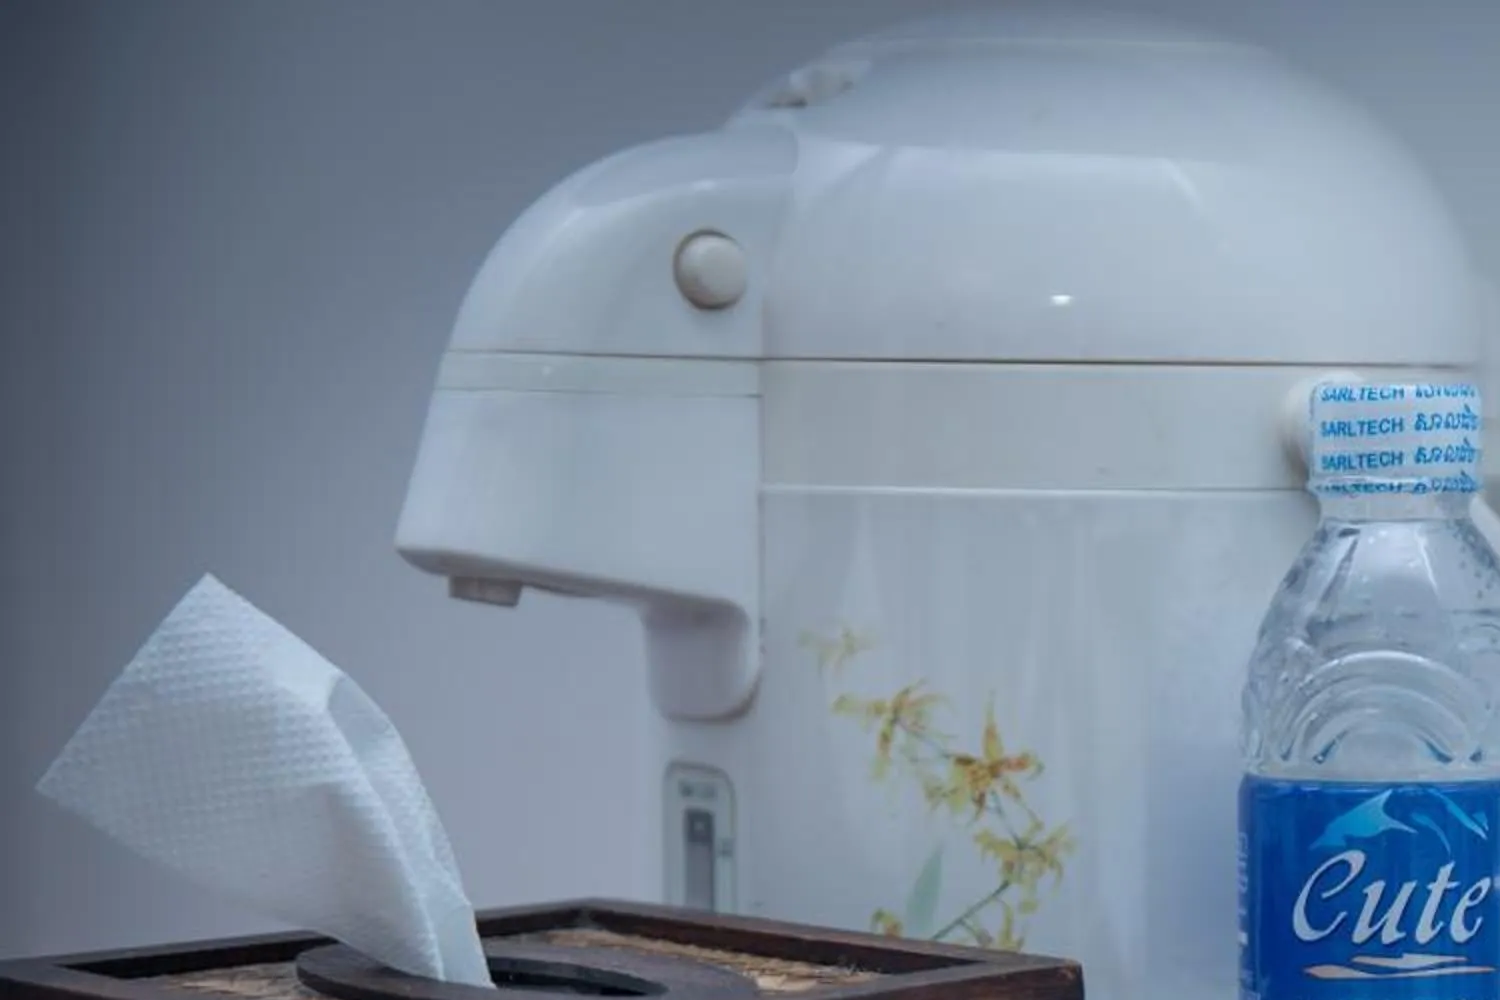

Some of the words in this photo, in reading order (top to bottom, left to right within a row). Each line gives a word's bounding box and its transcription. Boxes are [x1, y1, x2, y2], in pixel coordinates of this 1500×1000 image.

[1320, 417, 1405, 438] SARLTECH
[1320, 450, 1405, 471] SARLTECH
[1291, 849, 1492, 946] Cute
